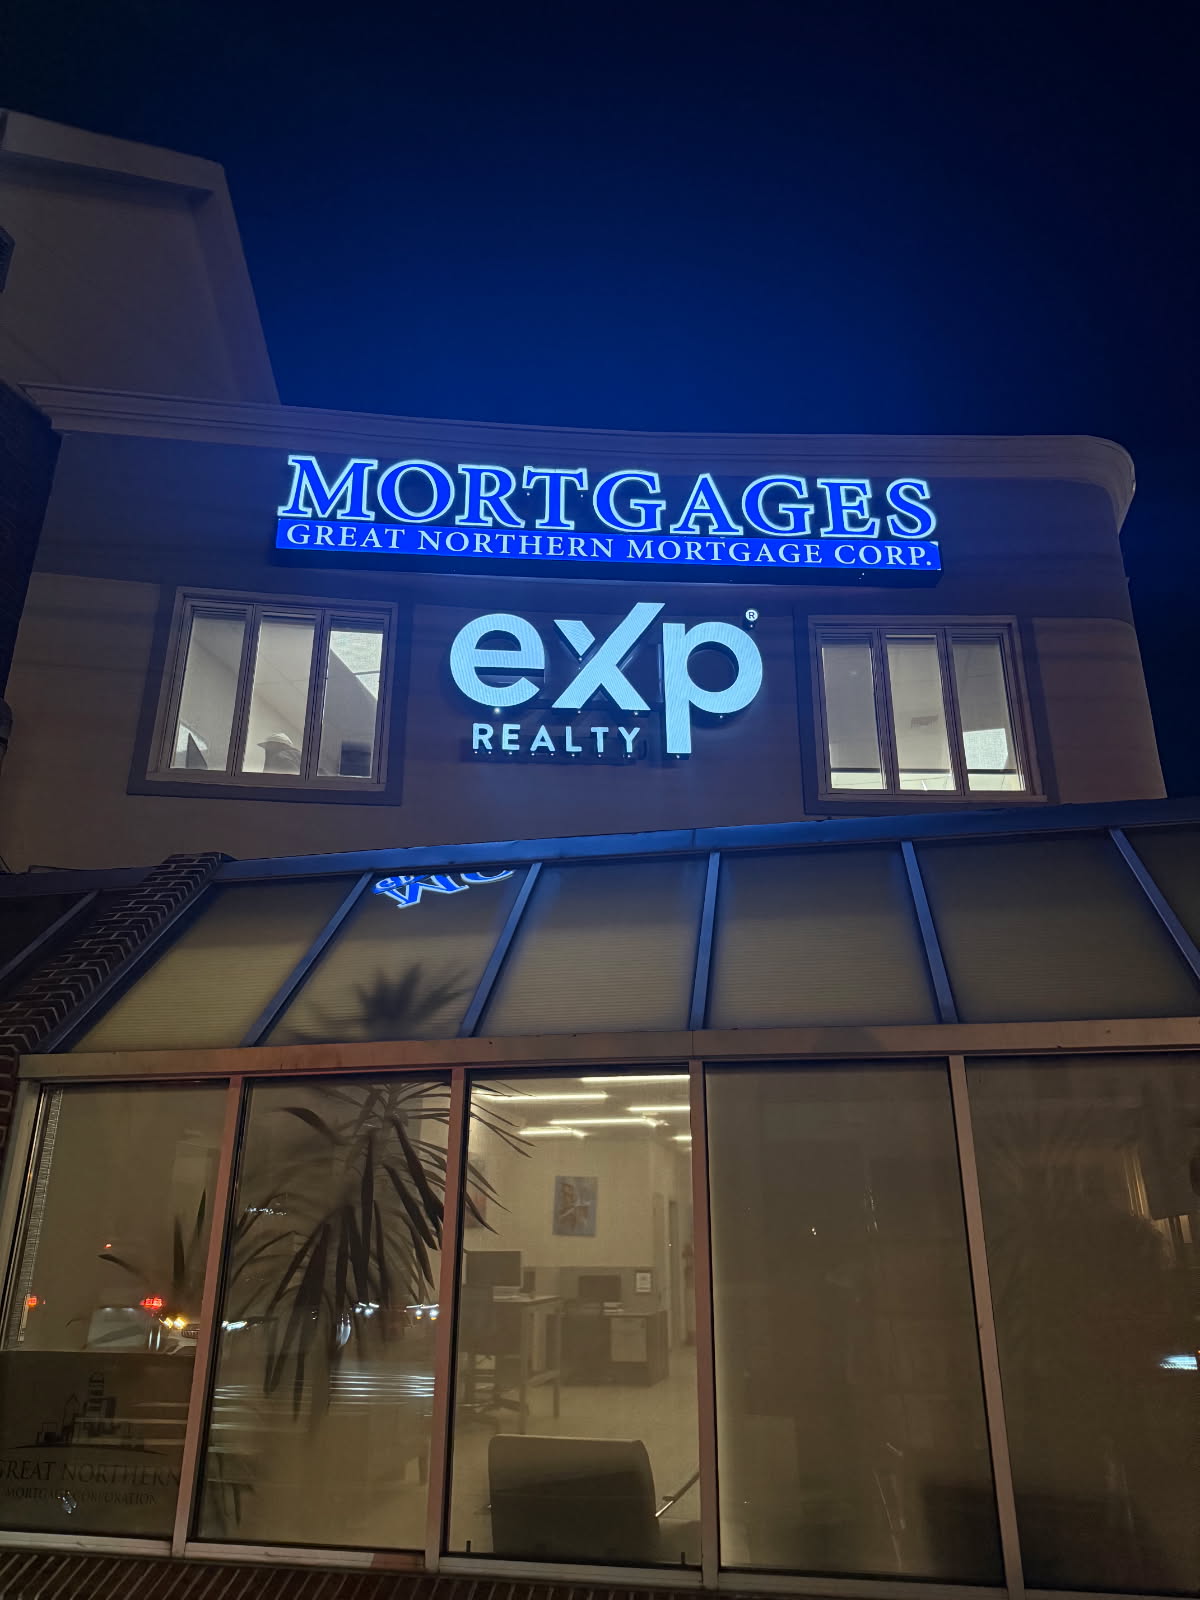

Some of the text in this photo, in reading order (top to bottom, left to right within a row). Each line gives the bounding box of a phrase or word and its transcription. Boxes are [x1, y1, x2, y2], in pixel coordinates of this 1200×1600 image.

[277, 455, 937, 539] MORTGAGES
[286, 524, 932, 567] GREAT NORTHERN MORTGAGE CORP.
[472, 722, 641, 753] REALTY
